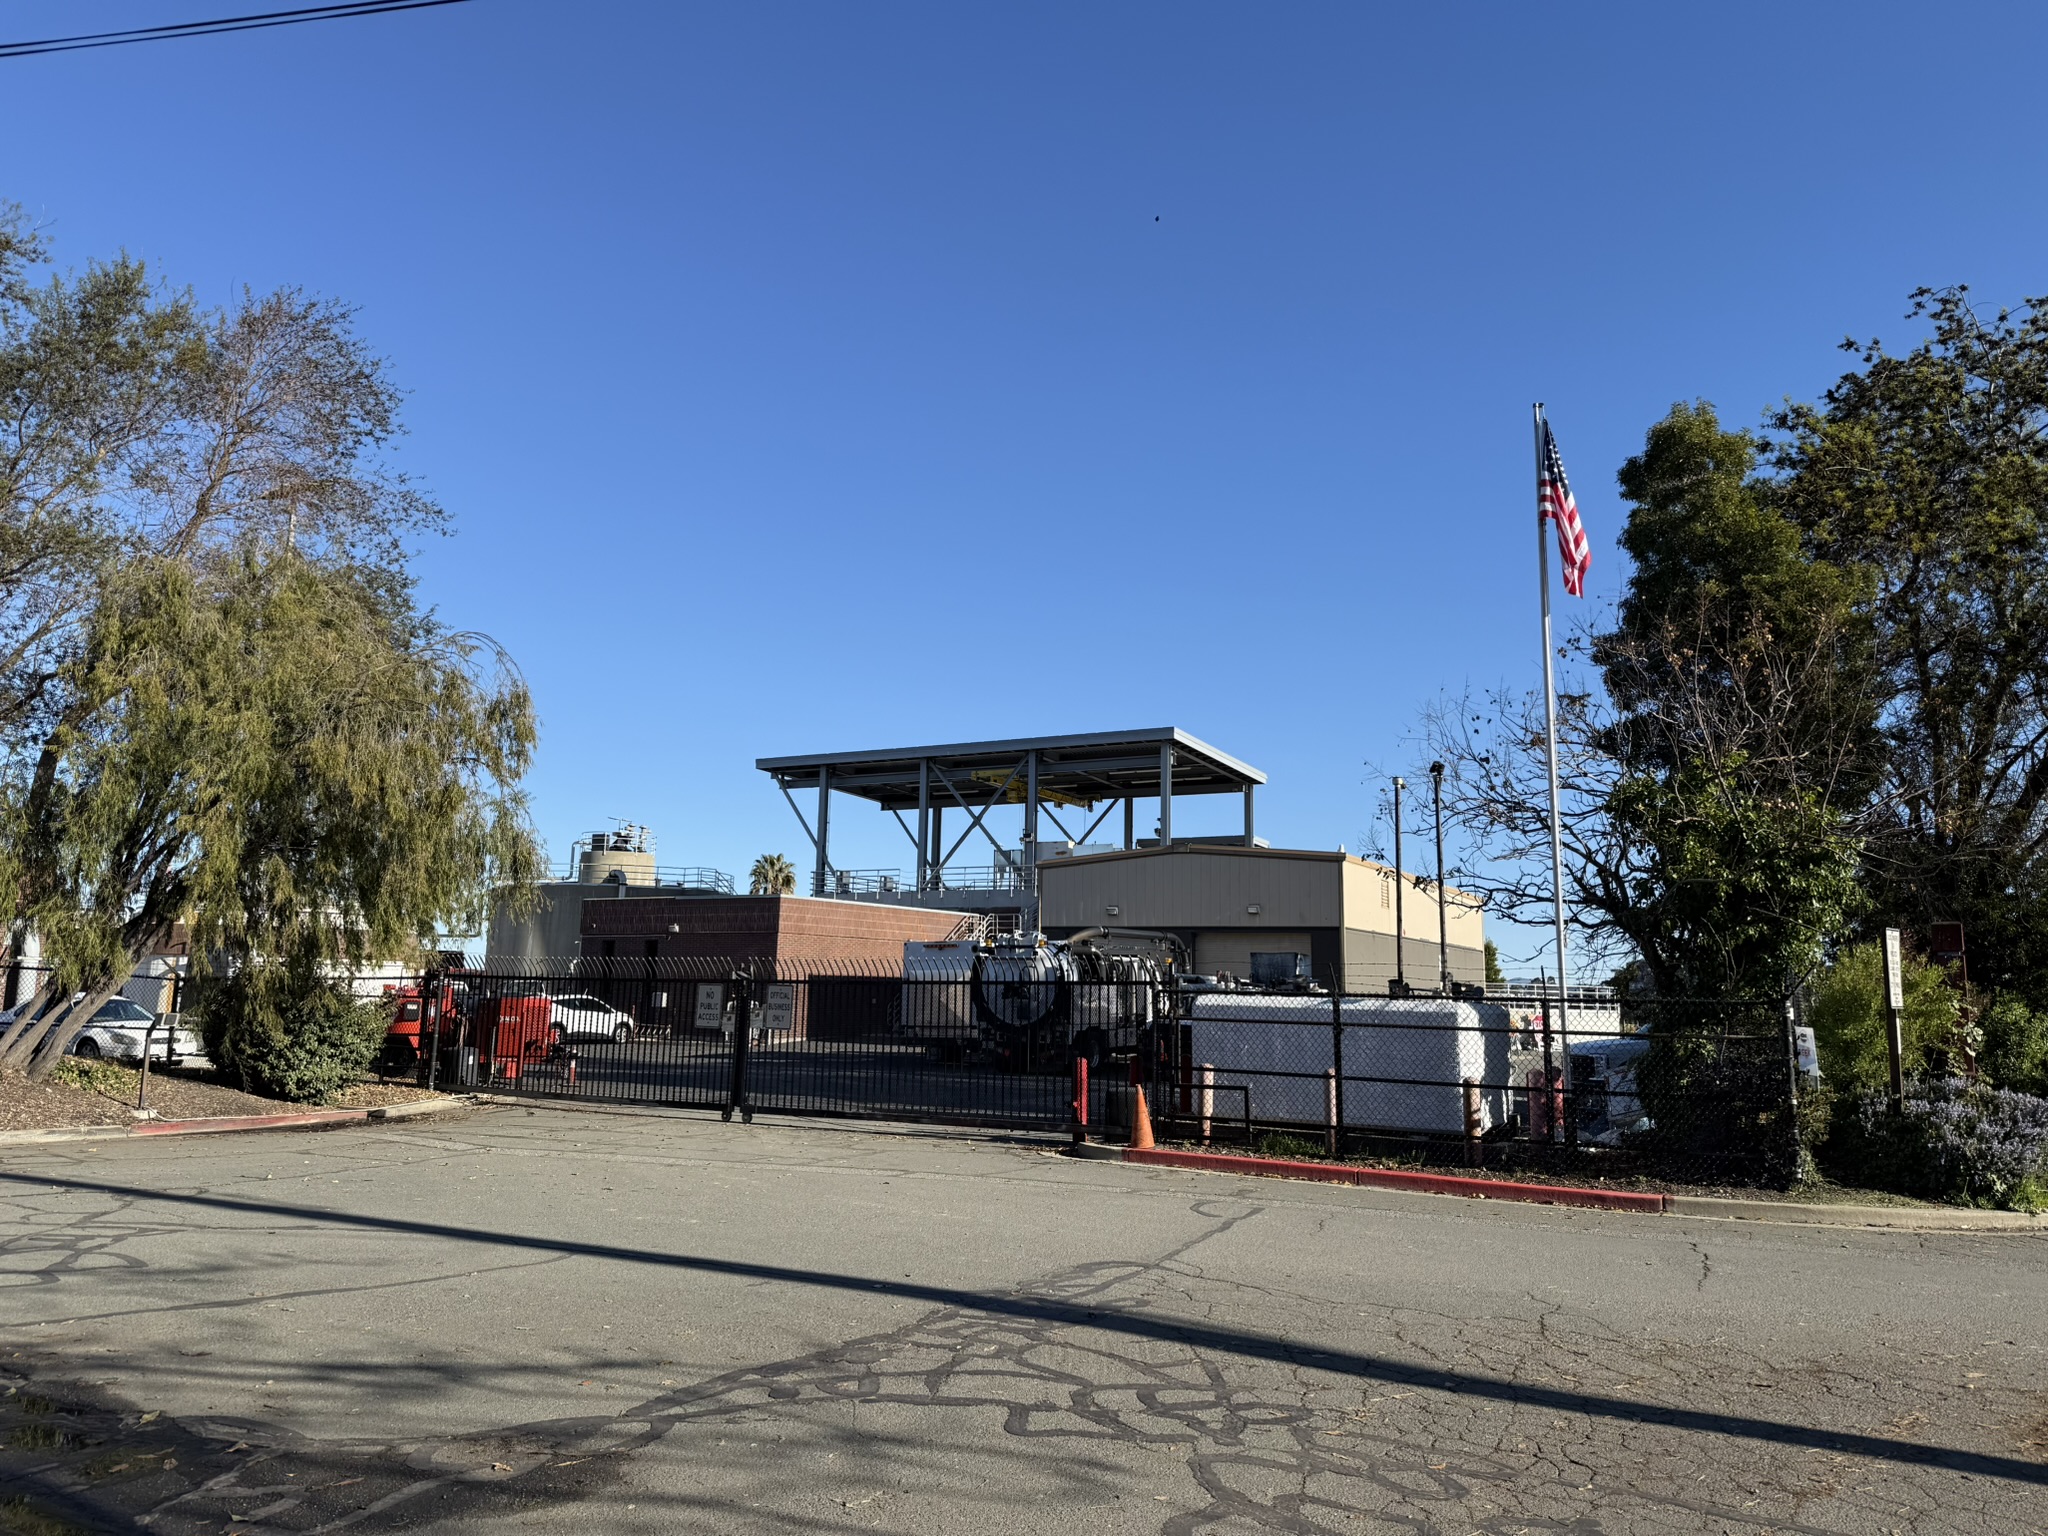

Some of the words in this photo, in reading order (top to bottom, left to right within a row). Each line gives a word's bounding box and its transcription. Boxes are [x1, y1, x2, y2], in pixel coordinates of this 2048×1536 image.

[706, 991, 714, 999] NO
[700, 1002, 718, 1010] PUBLIC
[768, 1003, 790, 1011] BUSINESS
[698, 1013, 718, 1021] ACCESS
